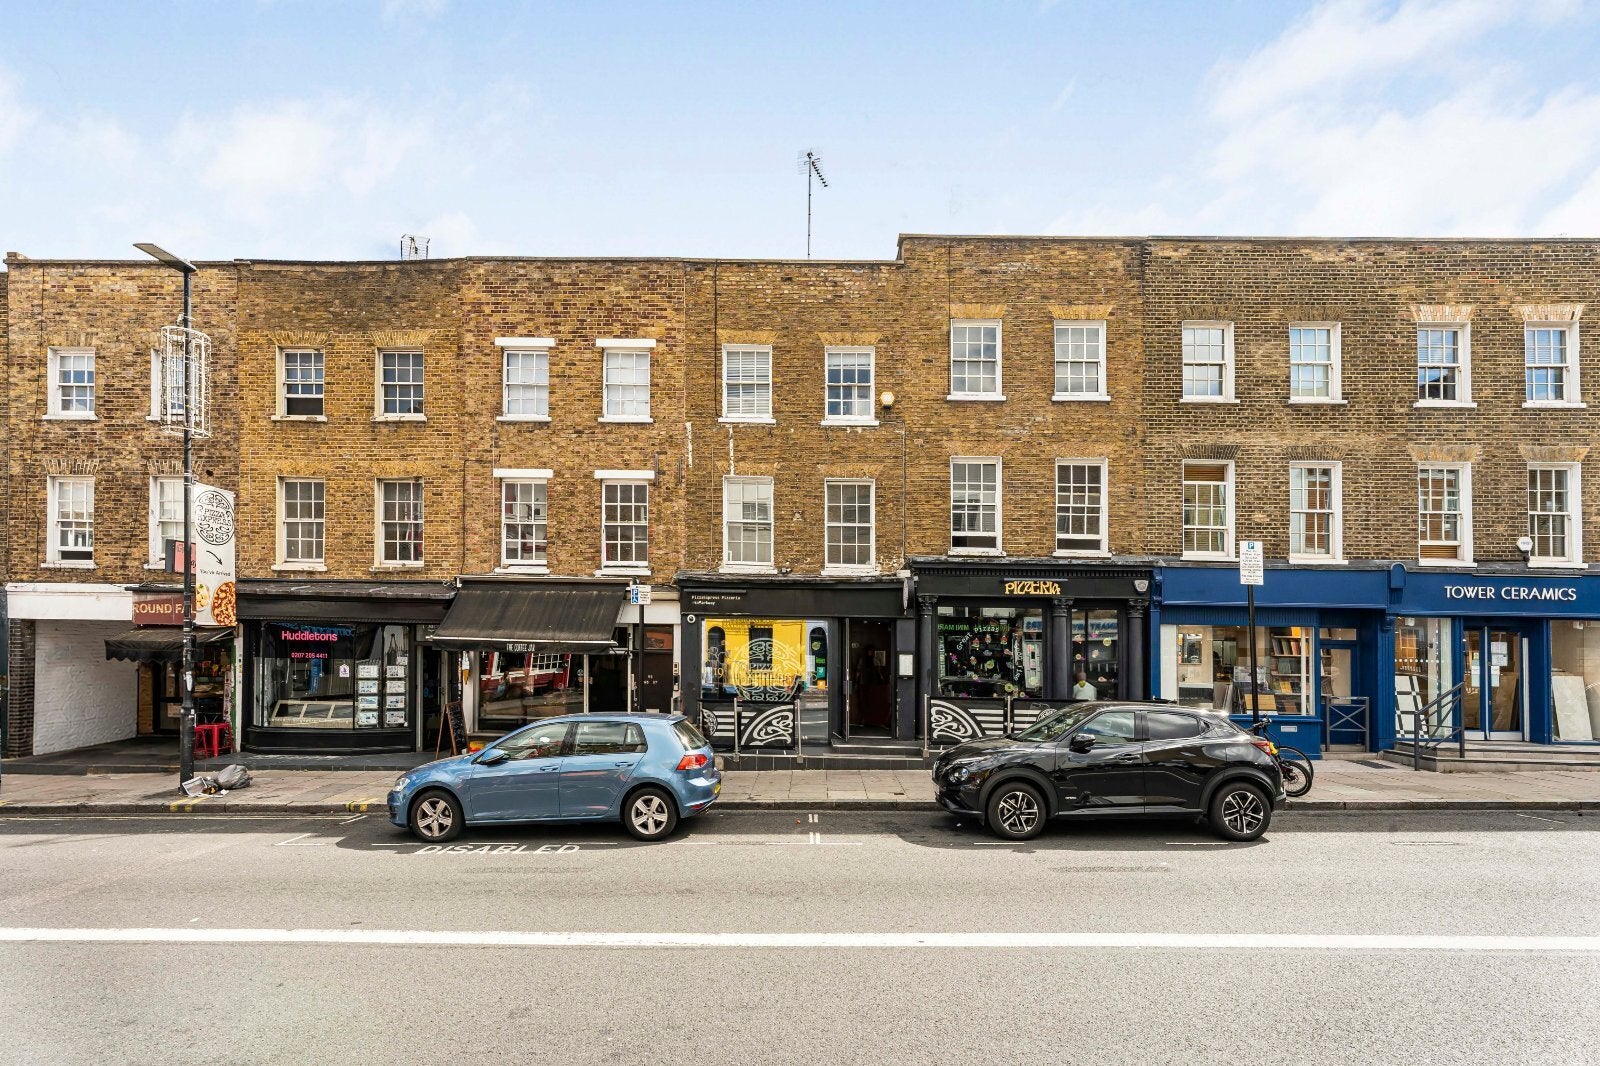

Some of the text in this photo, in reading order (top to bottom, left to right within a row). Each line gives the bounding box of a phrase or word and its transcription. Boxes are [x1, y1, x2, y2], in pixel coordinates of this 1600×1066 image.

[204, 508, 225, 517] PIZZA
[1004, 580, 1060, 595] PIZZERIA
[1444, 586, 1577, 601] TOWER CERAMICS
[281, 630, 338, 642] Huddletons
[413, 845, 580, 855] DISABLED
